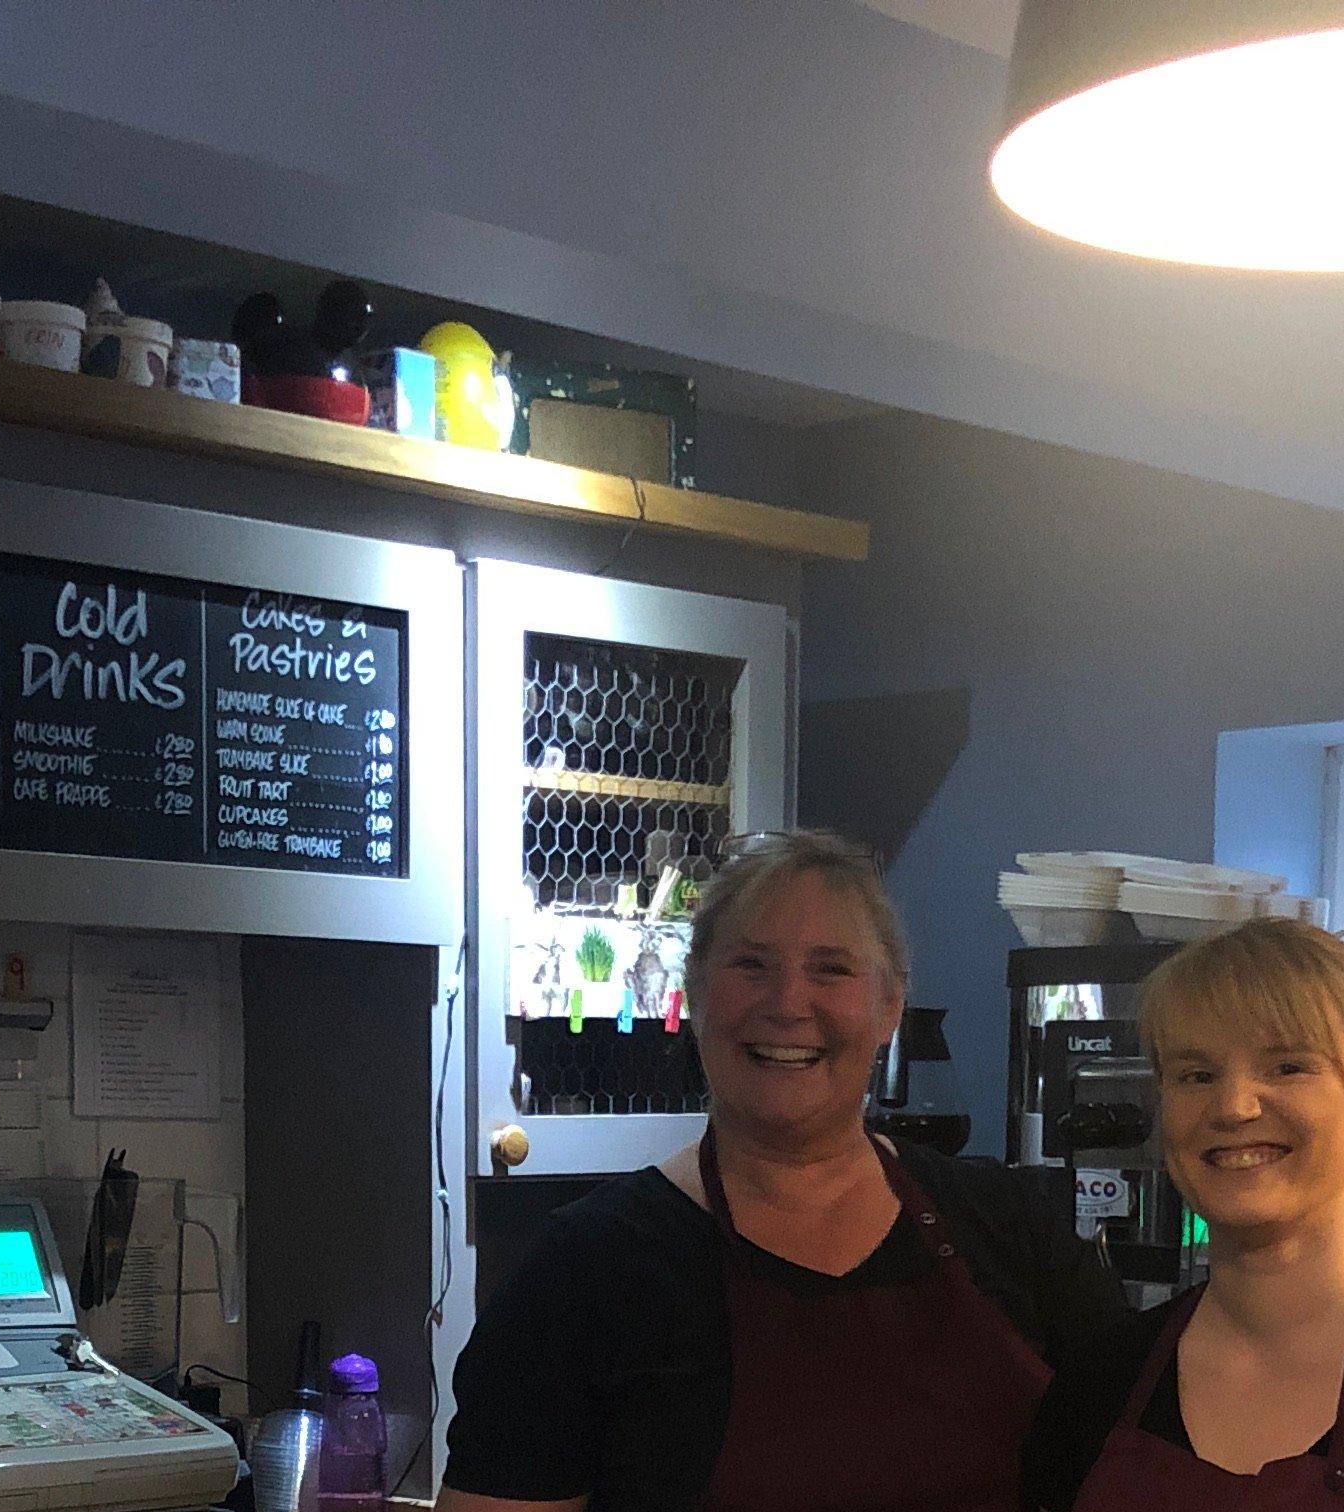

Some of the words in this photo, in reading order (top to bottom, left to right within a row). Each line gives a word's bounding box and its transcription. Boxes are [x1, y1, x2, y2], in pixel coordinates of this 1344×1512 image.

[56, 582, 147, 645] Cold
[241, 592, 327, 637] Cakes
[21, 643, 187, 710] Drinks
[229, 632, 377, 685] Pastries
[14, 721, 97, 748] MILKSHAKE
[13, 750, 96, 776] SMOOTHIE
[219, 774, 257, 799] FRUIT
[258, 780, 293, 802] TART
[217, 804, 289, 827] CUPCAKES
